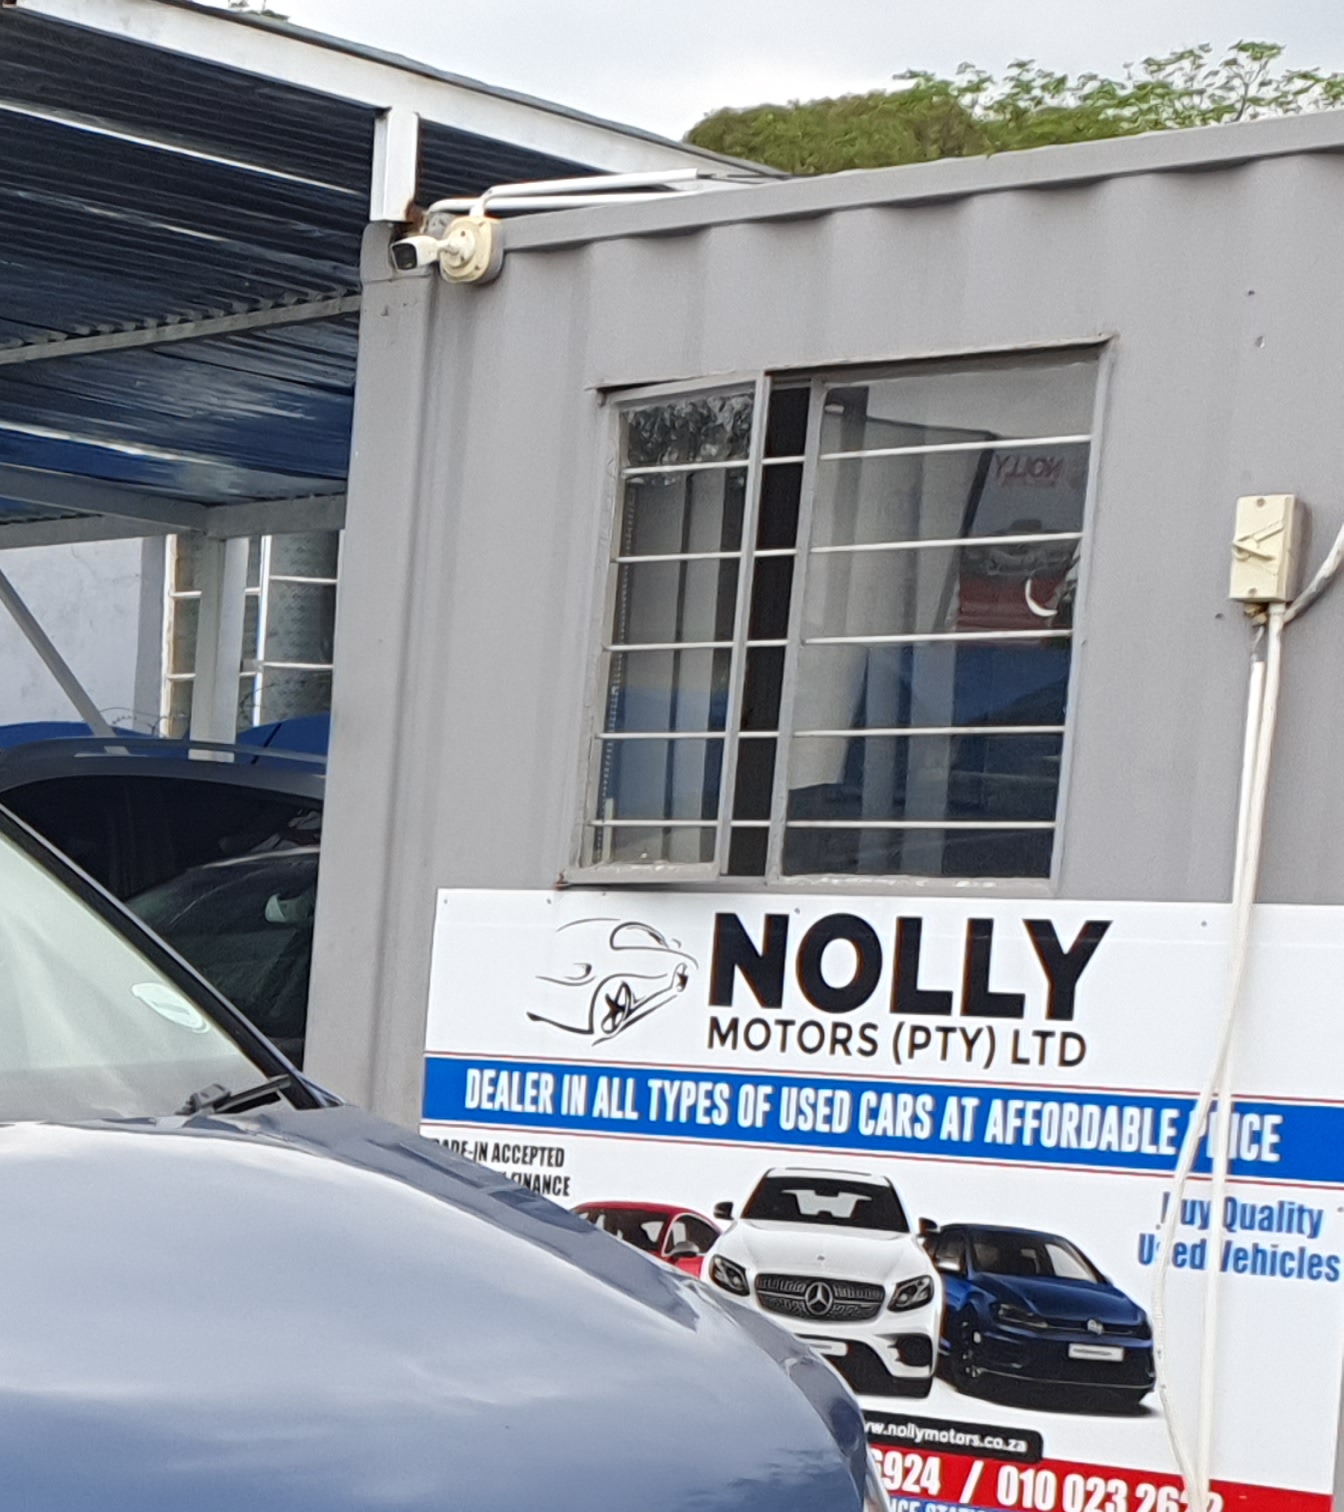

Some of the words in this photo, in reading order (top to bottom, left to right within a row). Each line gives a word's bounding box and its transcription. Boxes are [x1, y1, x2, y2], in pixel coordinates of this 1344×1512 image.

[708, 912, 1114, 1021] NOLLY
[707, 1016, 879, 1057] MOTORS
[892, 1021, 997, 1070] (PTY)
[1011, 1028, 1087, 1068] LTD
[465, 1068, 555, 1115] DEALER
[561, 1073, 589, 1117] IN
[592, 1076, 639, 1120] ALL
[647, 1079, 731, 1126] TYPES
[737, 1083, 774, 1128] OF
[779, 1086, 852, 1134] USED
[858, 1090, 935, 1140] CARS
[939, 1096, 980, 1142] AT
[984, 1098, 1180, 1156] AFFORDABLE
[491, 1142, 565, 1168] ACCEPTED
[1221, 1195, 1324, 1239] Quality
[1137, 1232, 1208, 1271] Ued
[996, 1464, 1057, 1512] 010
